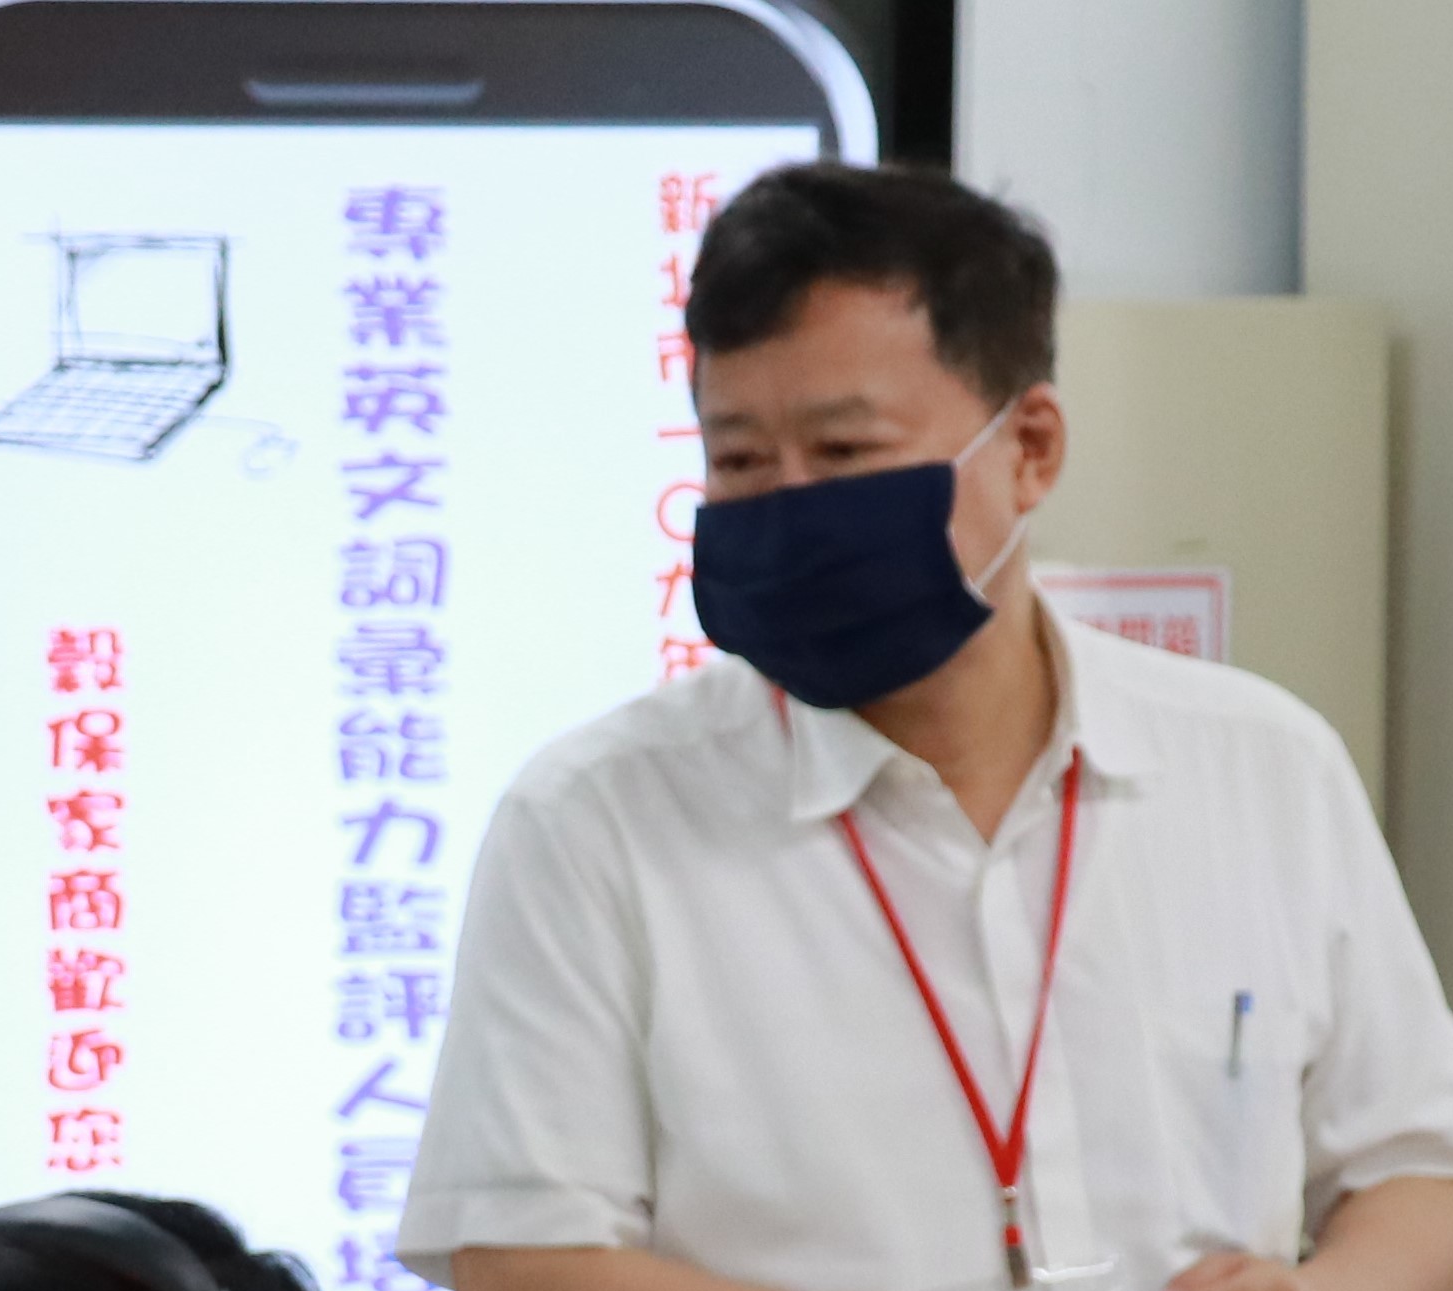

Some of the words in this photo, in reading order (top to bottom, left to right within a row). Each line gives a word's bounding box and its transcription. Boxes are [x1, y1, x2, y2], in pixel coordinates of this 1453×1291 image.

[45, 626, 125, 1173] 穀保家商歡迎您
